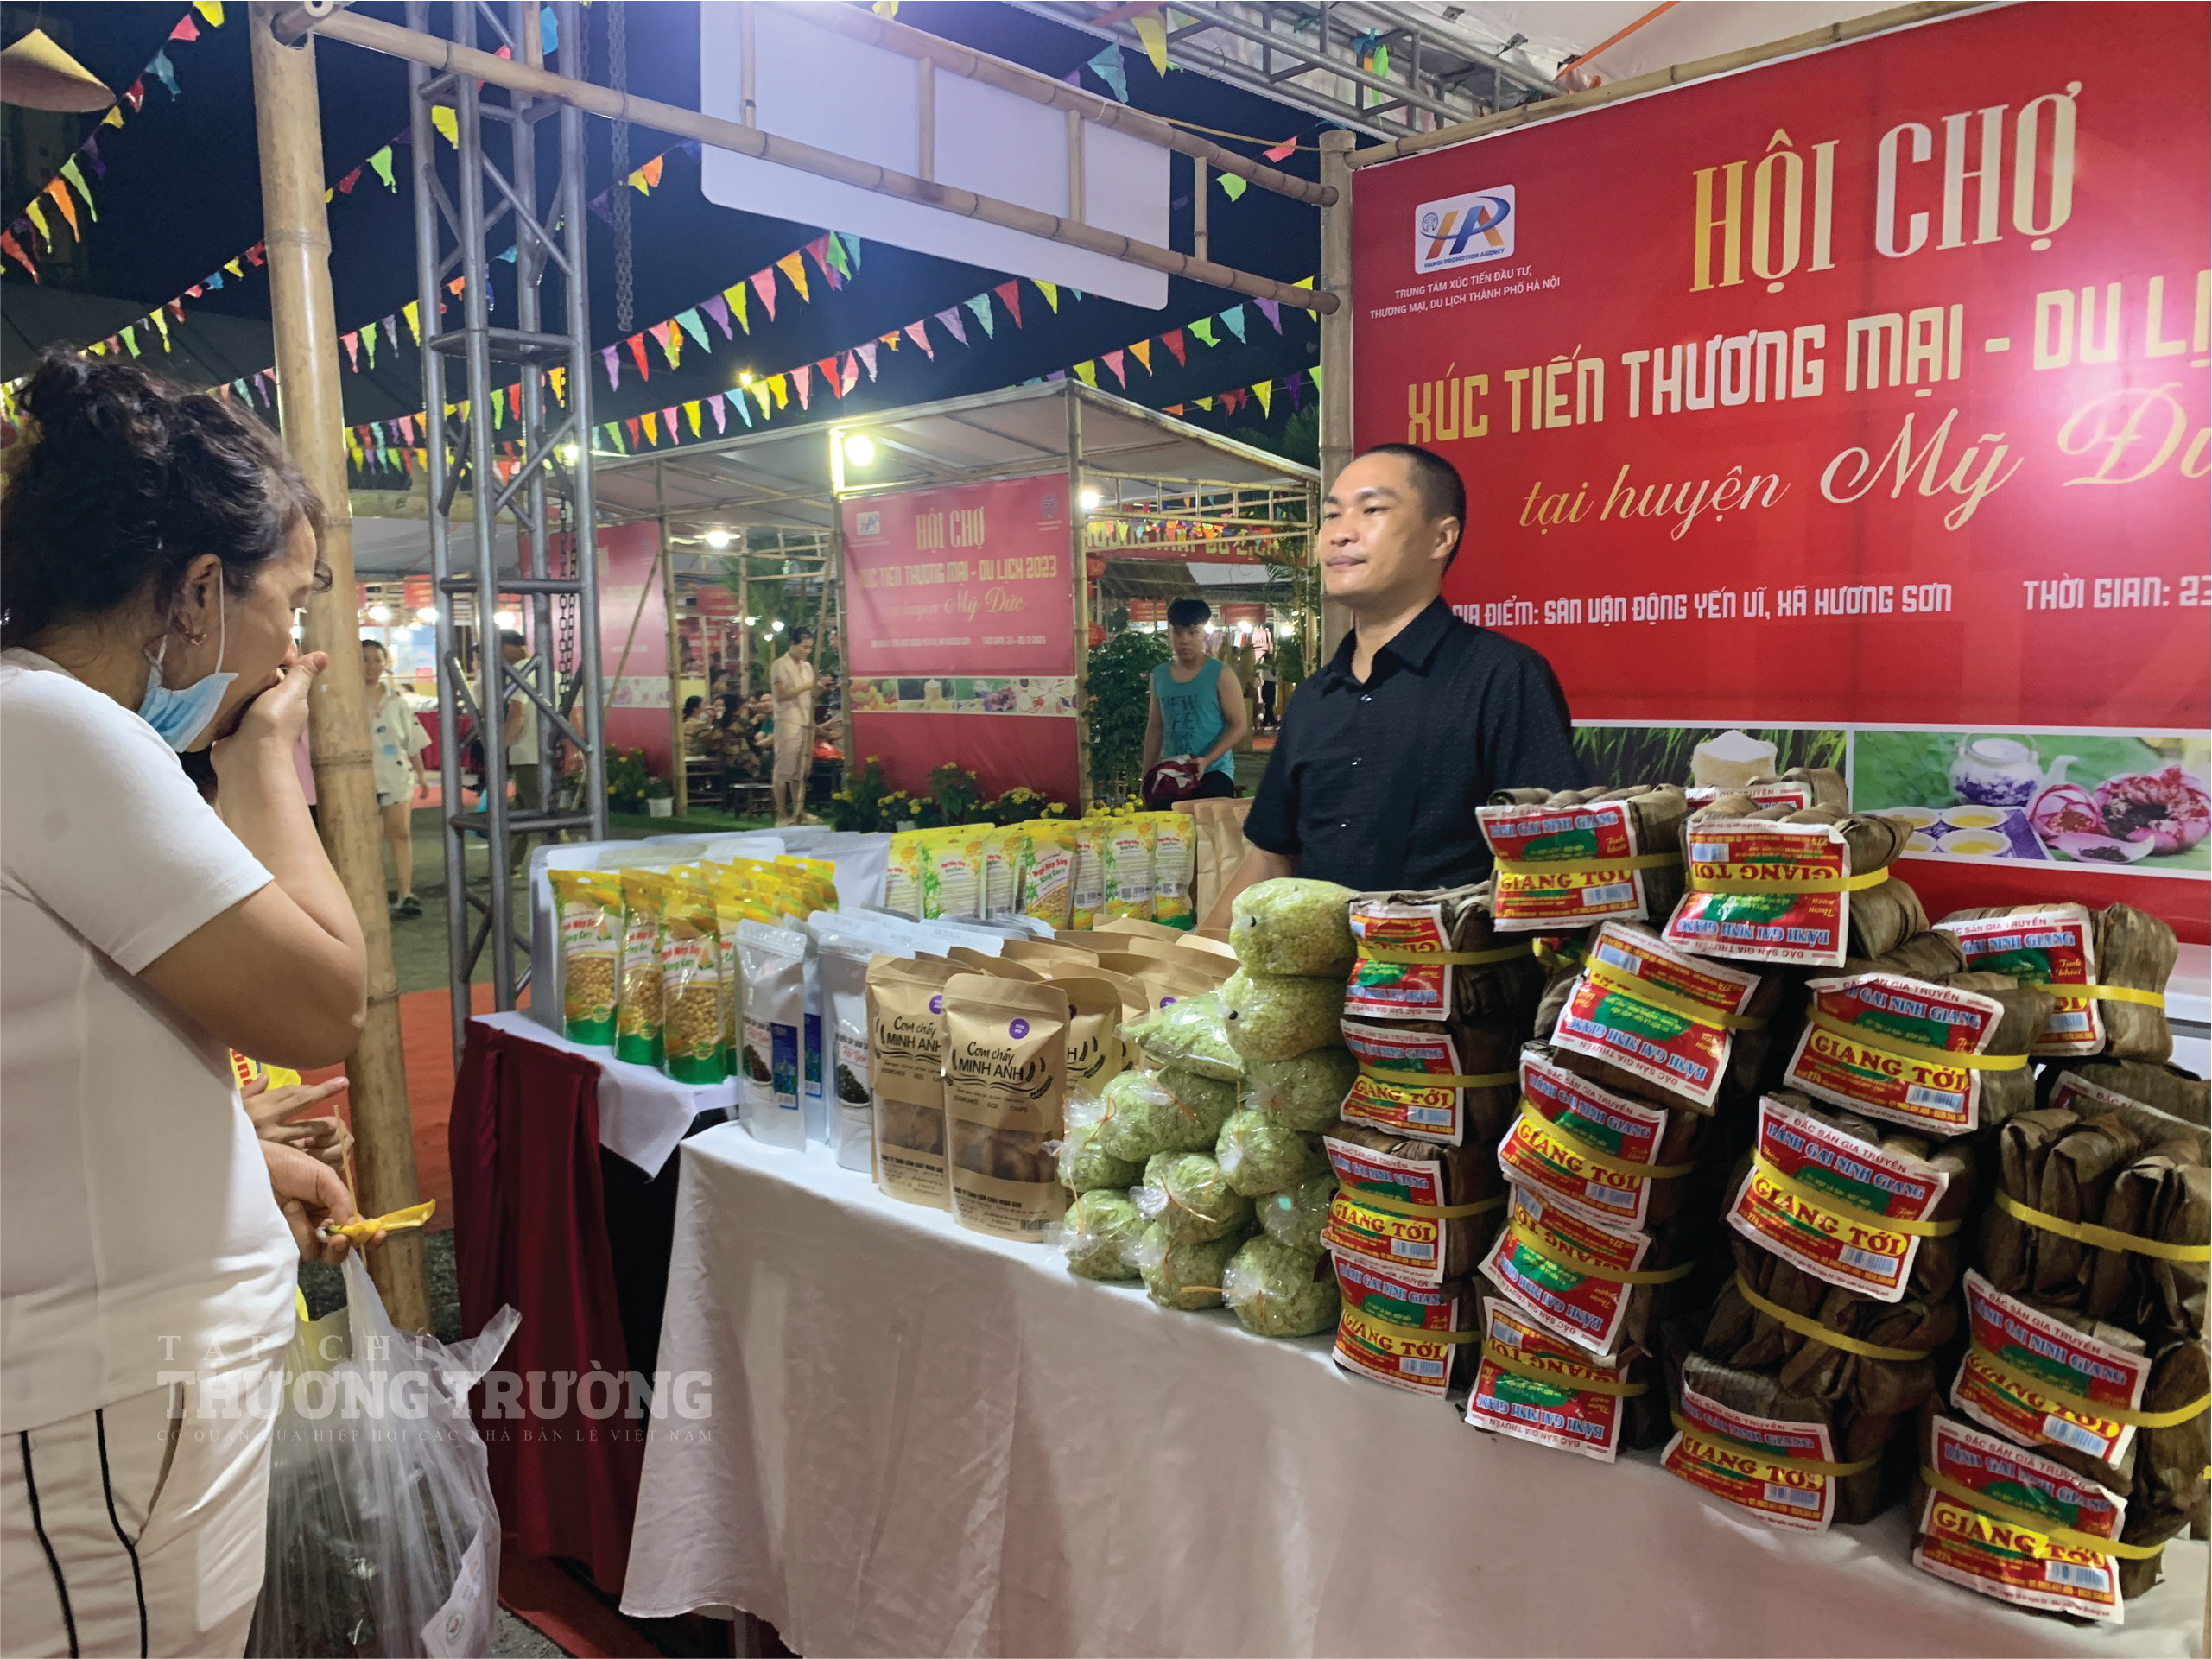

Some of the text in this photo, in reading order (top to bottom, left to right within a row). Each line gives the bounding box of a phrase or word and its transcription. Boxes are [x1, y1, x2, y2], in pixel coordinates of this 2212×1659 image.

[1689, 80, 2082, 293] HỘI CHỢ
[1370, 305, 1407, 319] THƯƠNG
[1430, 299, 1443, 309] DU
[1445, 294, 1467, 308] LỊCH
[1468, 287, 1501, 301] THÀNH
[1503, 280, 1524, 296] PHỐ
[1526, 278, 1541, 291] HÀ
[1543, 275, 1561, 289] NỘI
[1395, 285, 1425, 299] TRUNG
[1428, 279, 1448, 293] TÂM
[1449, 276, 1468, 288] XÚC
[1470, 271, 1492, 285] TIẾN
[1493, 267, 1514, 281] ĐẦU
[1407, 362, 1489, 445] XÚC
[1504, 344, 1605, 433] TIẾN
[1621, 324, 1826, 419] THƯƠNG
[1845, 304, 1964, 397] MẠI
[2033, 282, 2121, 370] DU
[1518, 480, 1594, 535] tại
[1600, 464, 1791, 541] huyện
[1820, 408, 2025, 531] Mỹ
[916, 506, 986, 554] HỘI CHỢ
[979, 559, 995, 581] DU
[997, 557, 1024, 584] LỊCH
[1026, 555, 1058, 579] 2023
[1484, 595, 1539, 627] ĐIỂM:
[1544, 597, 1581, 624] SÂN
[1588, 595, 1626, 627] VẬN
[1632, 592, 1688, 625] ĐỘNG
[1694, 586, 1737, 619] YẾN
[1777, 585, 1807, 617] XÃ
[1814, 585, 1894, 616] HƯƠNG
[1901, 583, 1952, 613] SƠN
[2022, 572, 2085, 610] THỜI
[2094, 577, 2171, 609] GIAN:
[1500, 874, 1572, 891] GIANG
[1721, 921, 1754, 939] NINH
[1787, 928, 1830, 947] BÁNH
[1889, 995, 1927, 1019] NINH
[1930, 1006, 1981, 1029] GIANG
[887, 1033, 916, 1049] MINH
[959, 1058, 1024, 1080] MINH ANH
[1669, 1055, 1708, 1081] BÁNH
[1815, 1035, 1968, 1092] GIANG TỚI
[1410, 1090, 1450, 1107] TỚI
[1518, 1123, 1583, 1174] GIANG
[1767, 1121, 1925, 1200] BÁNH GAI NINH GIANG
[1841, 1140, 1859, 1154] GIA
[1335, 1203, 1432, 1243] GIANG TỚI
[1755, 1177, 1839, 1235] GIANG
[1849, 1225, 1902, 1256] TỚI
[1567, 1303, 1604, 1331] BÁNH
[1568, 1415, 1605, 1439] BÁNH
[1936, 1509, 2038, 1555] GIANG
